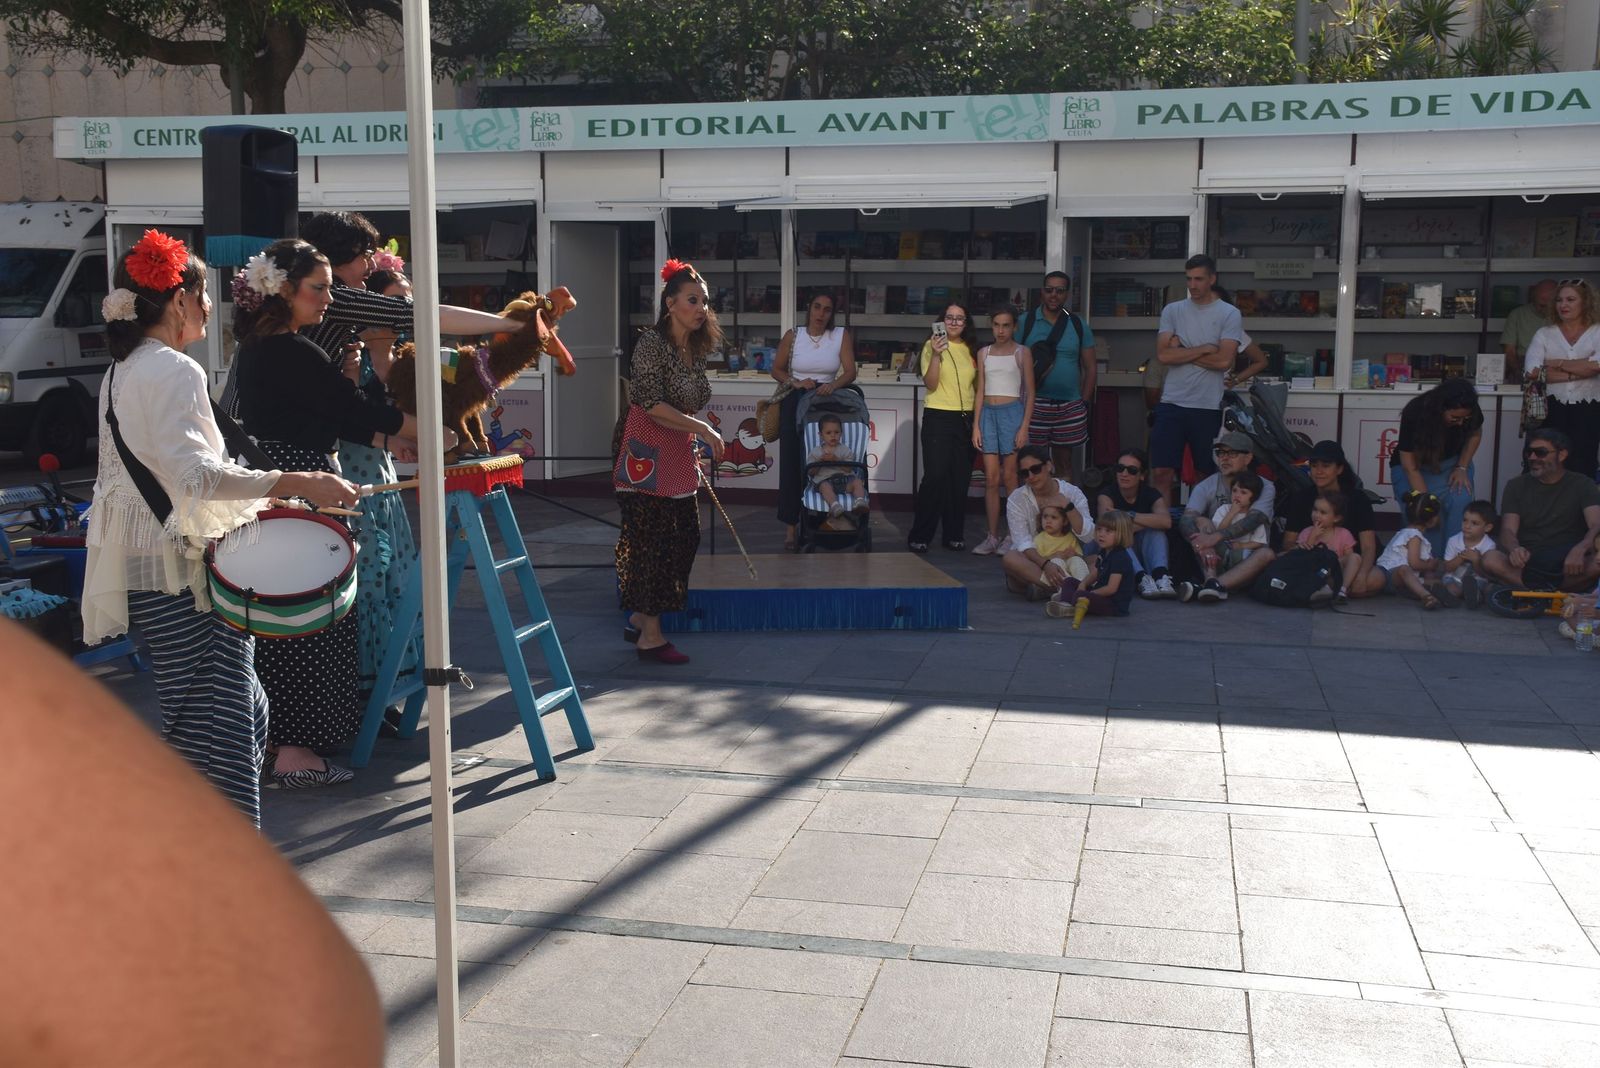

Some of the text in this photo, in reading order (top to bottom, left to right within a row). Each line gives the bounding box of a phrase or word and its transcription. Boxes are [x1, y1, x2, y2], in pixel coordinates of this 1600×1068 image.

[1062, 96, 1101, 115] feria
[1136, 87, 1592, 126] PALABRAS DE VIDA
[587, 114, 796, 138] EDITORIAL
[817, 110, 956, 133] AVANT
[1063, 113, 1102, 130] LIBRO
[332, 126, 358, 143] AL
[365, 123, 443, 142] IDRII
[1067, 129, 1093, 137] CEUTA
